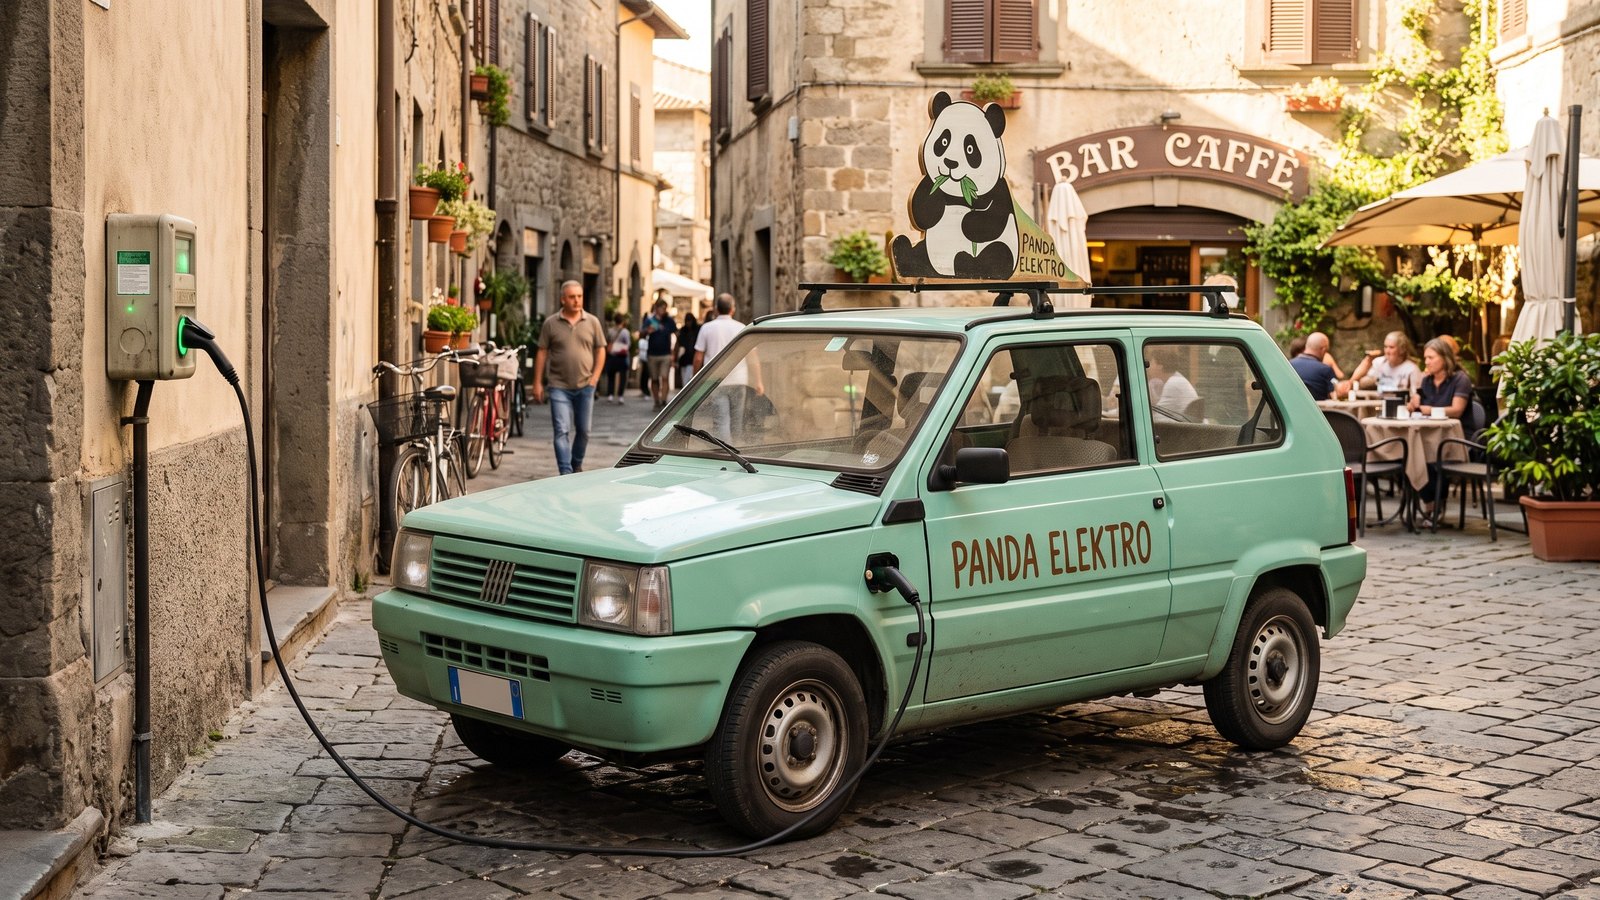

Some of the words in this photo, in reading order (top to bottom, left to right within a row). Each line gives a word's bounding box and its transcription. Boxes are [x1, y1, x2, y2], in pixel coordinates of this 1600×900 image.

[1046, 136, 1138, 184] BAR
[1022, 233, 1055, 256] PANDA
[1020, 257, 1065, 277] ELEKTRO
[951, 533, 1039, 589] PANDA
[1049, 520, 1152, 576] ELEKTRO
